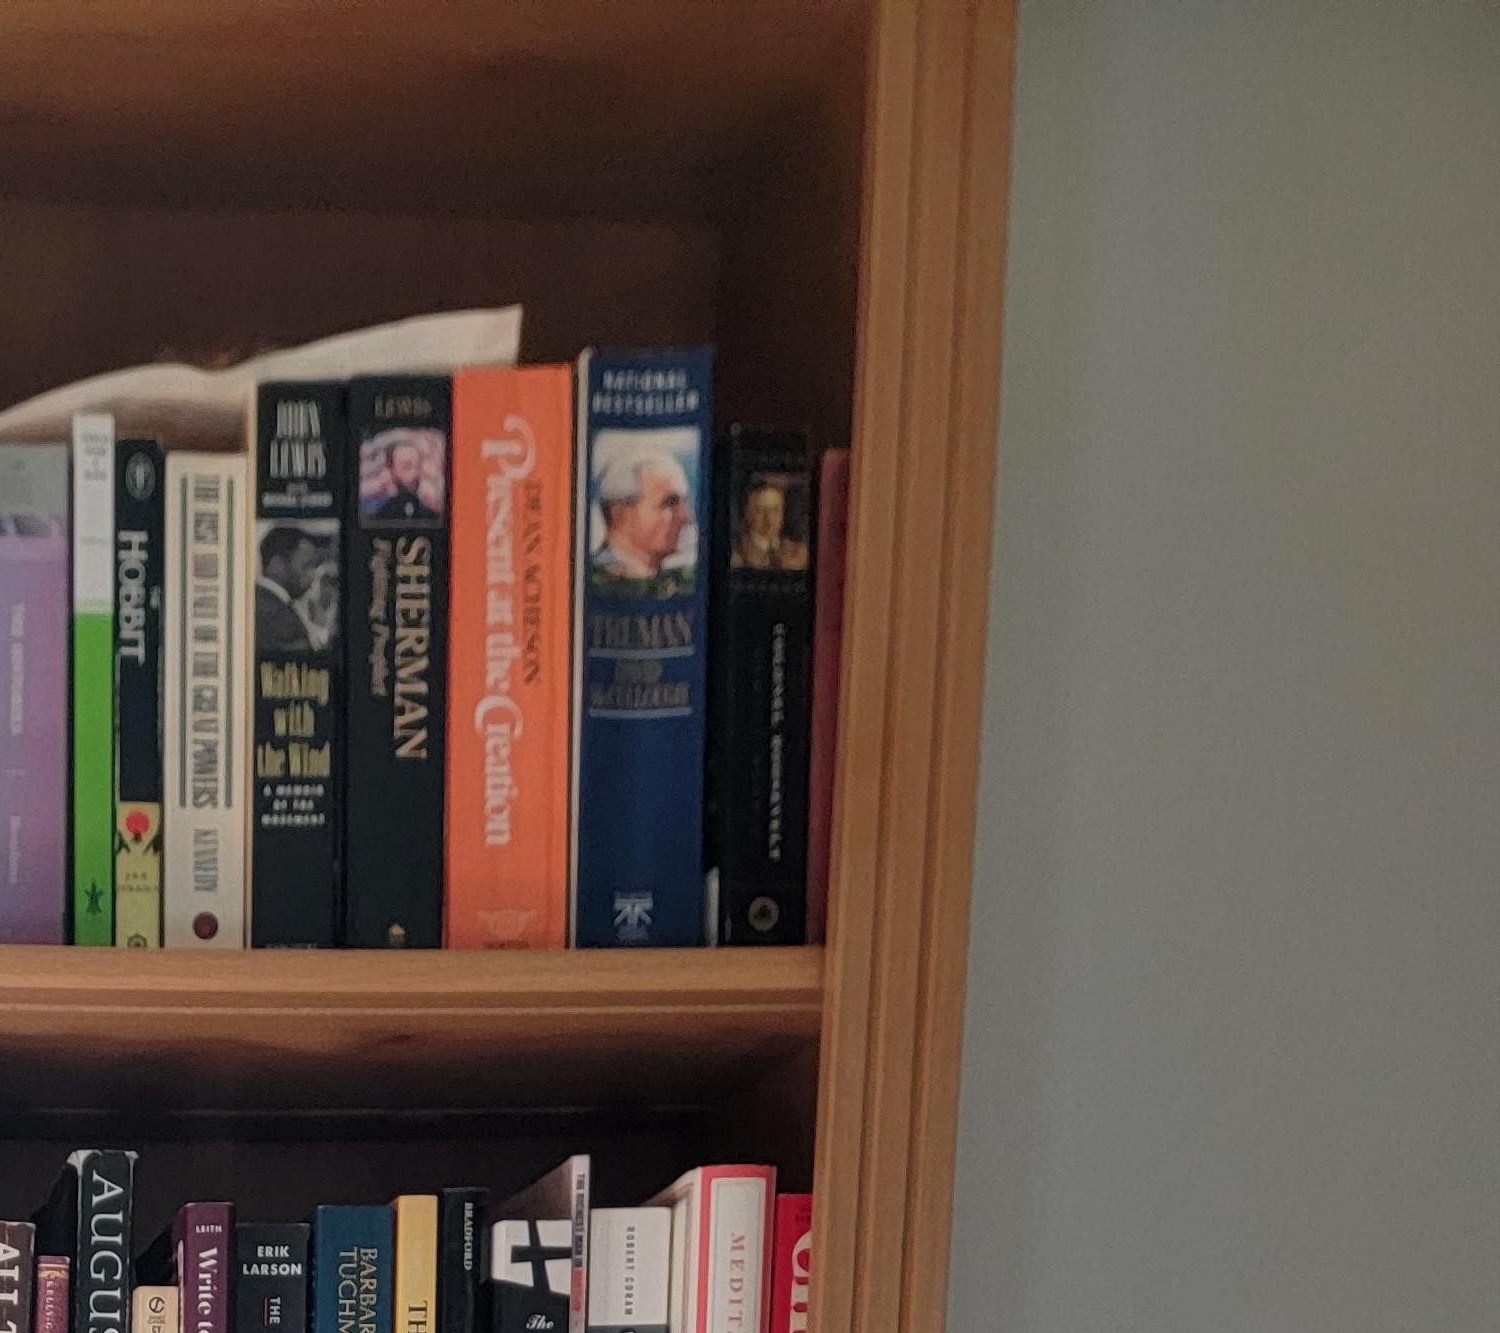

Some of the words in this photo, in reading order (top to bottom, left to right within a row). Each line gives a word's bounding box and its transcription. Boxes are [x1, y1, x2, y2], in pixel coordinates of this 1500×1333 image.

[480, 414, 535, 584] Present
[524, 480, 543, 552] DEAN
[118, 530, 149, 666] HOBBIT
[393, 536, 431, 760] SHERMAN
[486, 591, 517, 625] at
[523, 562, 542, 687] ACHESON
[486, 632, 518, 692] the
[474, 694, 523, 847] Creation
[268, 1296, 281, 1324] THE
